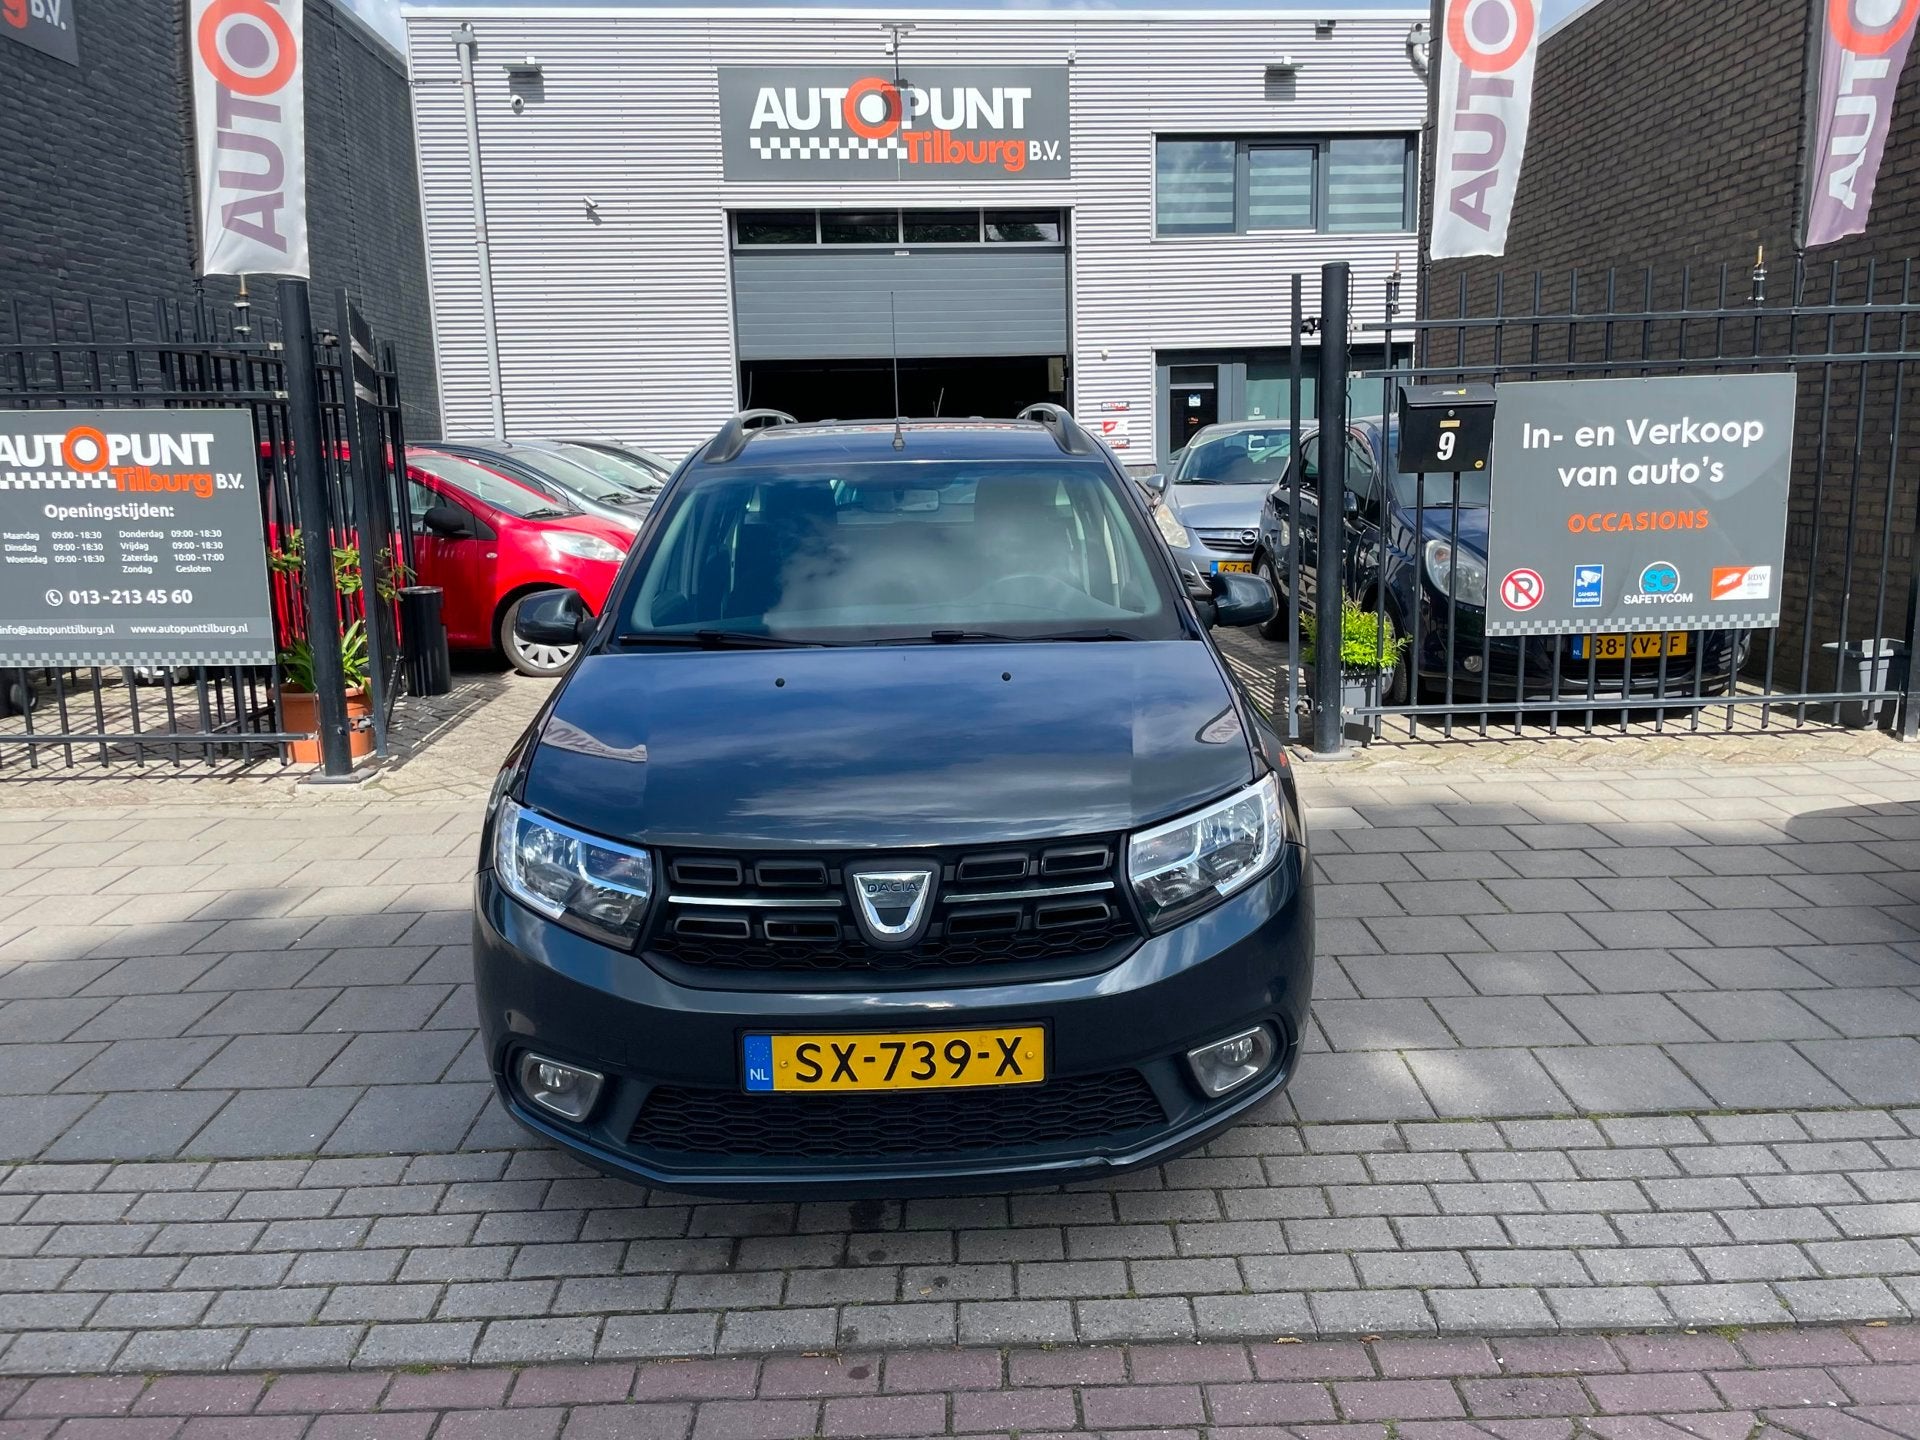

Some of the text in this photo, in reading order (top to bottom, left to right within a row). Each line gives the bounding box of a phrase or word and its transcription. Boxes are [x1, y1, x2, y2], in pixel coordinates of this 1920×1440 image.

[750, 77, 1032, 139] AUTOPUNT
[902, 130, 1061, 172] Tilburg B.V.
[1522, 416, 1764, 449] In- en Verkoop
[0, 426, 214, 474] AUTOPUNT
[1437, 431, 1456, 460] 9
[1558, 456, 1725, 487] van auto's
[111, 466, 245, 499] Tilburg B.V.
[45, 503, 175, 520] Openingstijden:
[1567, 508, 1710, 533] OCCASIONS
[2, 531, 40, 541] Maandag
[51, 531, 75, 539] 09:00
[80, 531, 102, 539] 18:30
[119, 529, 164, 540] Donderdag
[171, 530, 194, 538] 09:00
[199, 529, 222, 537] 18:30
[4, 543, 37, 553] Dinsdag
[53, 543, 76, 551] 09:00
[81, 543, 104, 551] 18:30
[120, 541, 149, 551] Vrijdag
[172, 541, 195, 550] 09:00
[201, 541, 223, 549] 18:30
[5, 555, 48, 565] Woensdag
[54, 555, 77, 563] 09:00
[83, 555, 105, 563] 18:30
[121, 553, 158, 563] Zaterdag
[174, 553, 196, 561] 10:00
[202, 553, 225, 561] 17:00
[122, 565, 212, 574] Zondag Gesloten
[146, 589, 168, 604] 45
[171, 589, 193, 604] 60
[1623, 592, 1693, 605] SAFETYCOM
[130, 623, 248, 635] www.autopunttilburg.nl
[868, 881, 918, 893] DACIA
[750, 1036, 1023, 1083] NL SX-739-X
